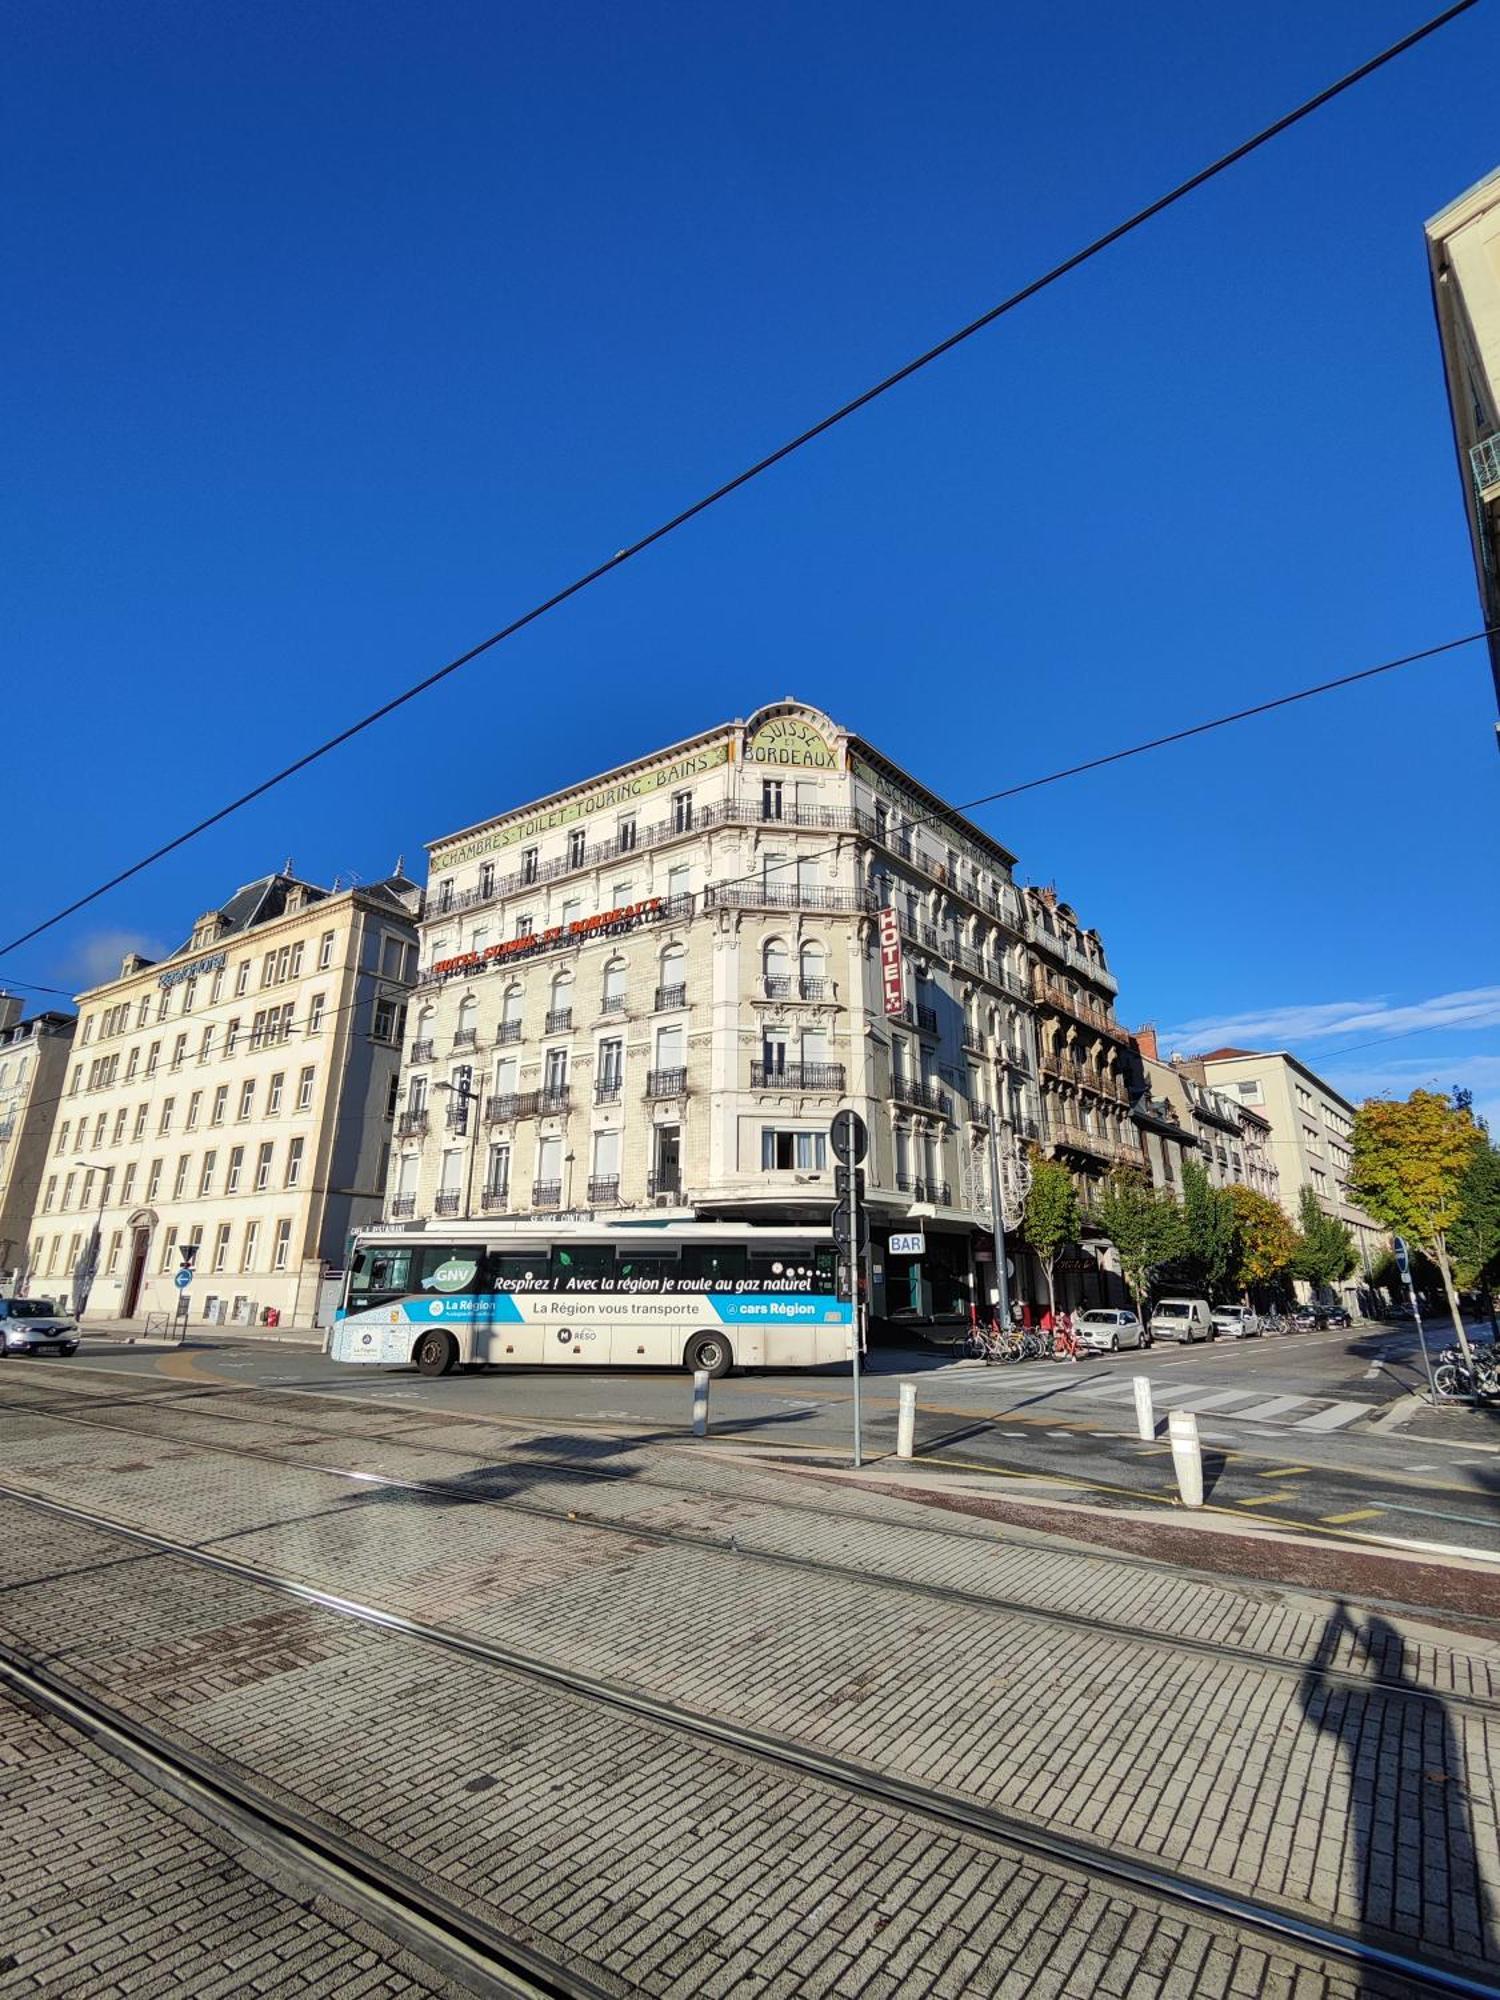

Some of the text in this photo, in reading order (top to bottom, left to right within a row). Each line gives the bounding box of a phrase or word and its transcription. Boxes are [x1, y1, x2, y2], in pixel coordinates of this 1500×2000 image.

[760, 721, 821, 747] SUISSE
[744, 745, 836, 768] BORDEAUX
[441, 833, 510, 869] CHAMBRES
[575, 780, 641, 816] TOURING
[656, 758, 708, 786] BAINS
[880, 910, 900, 999] HOTEL
[891, 1236, 921, 1250] BAR
[437, 1269, 468, 1281] GNV
[494, 1276, 550, 1293] Respirez
[566, 1277, 598, 1290] Avec
[601, 1277, 614, 1290] la
[617, 1276, 659, 1293] région
[660, 1277, 674, 1293] je
[677, 1277, 712, 1290] roule
[715, 1281, 729, 1290] au
[735, 1281, 760, 1294] gaz
[763, 1278, 812, 1291] naturel
[446, 1299, 496, 1312] La Région
[533, 1302, 700, 1316] La Région vous transporte
[739, 1302, 816, 1317] cars Région
